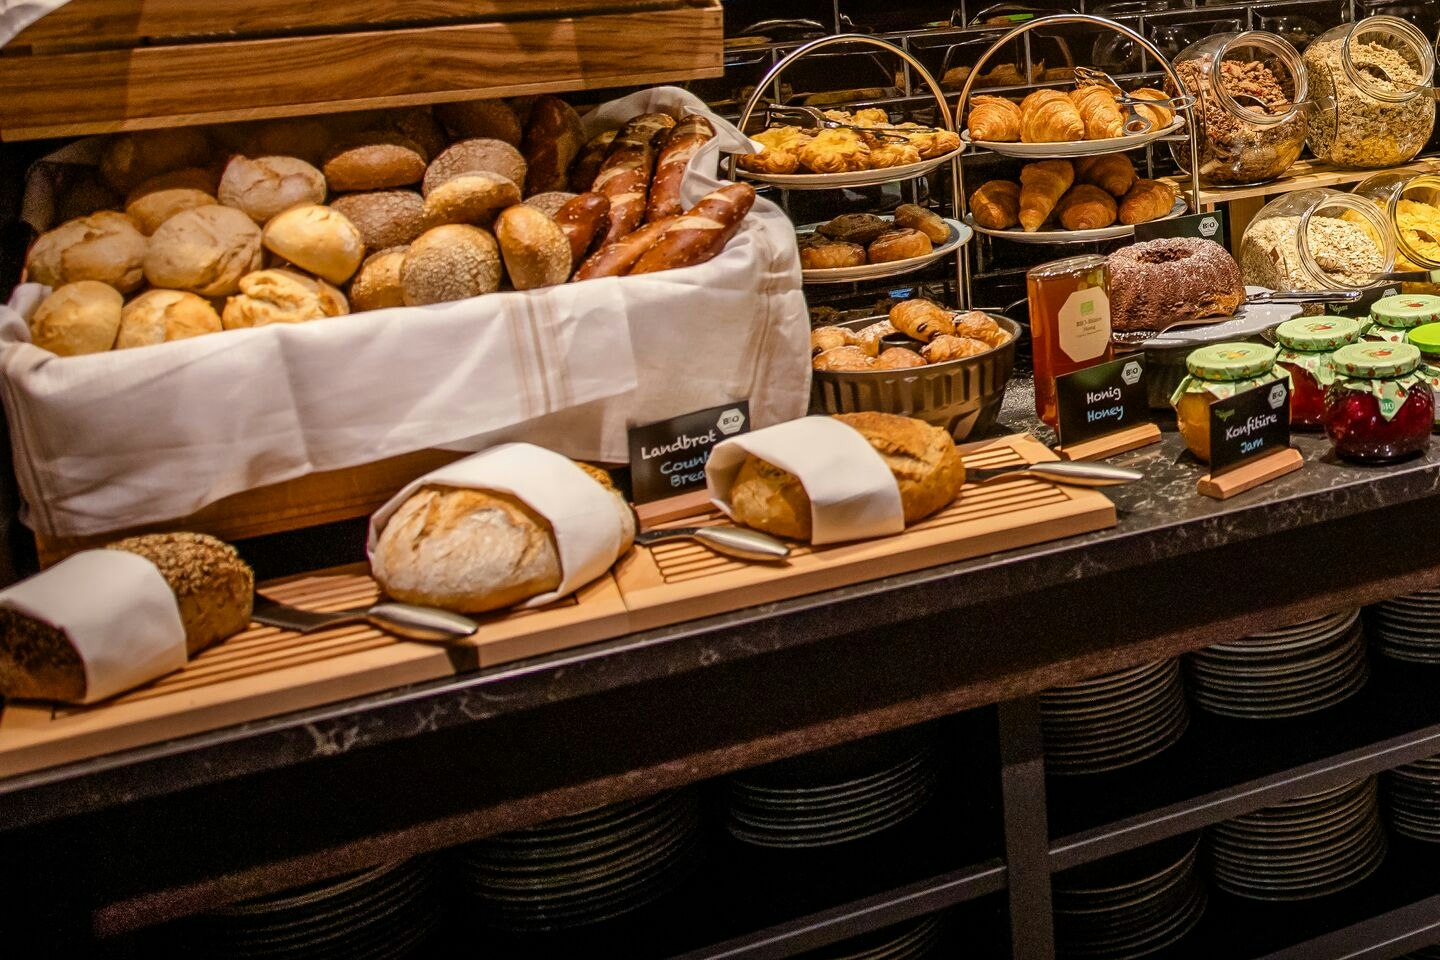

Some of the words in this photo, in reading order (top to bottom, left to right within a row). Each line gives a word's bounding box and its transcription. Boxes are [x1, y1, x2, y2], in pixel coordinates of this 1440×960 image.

[1126, 367, 1138, 376] BIO
[1086, 386, 1122, 404] Honig
[1272, 390, 1284, 400] BIO
[722, 415, 740, 425] BIO
[1087, 405, 1124, 422] Honey
[1225, 413, 1277, 441] Konfitüre
[641, 429, 718, 460] Landbrot
[1240, 437, 1264, 454] Jam
